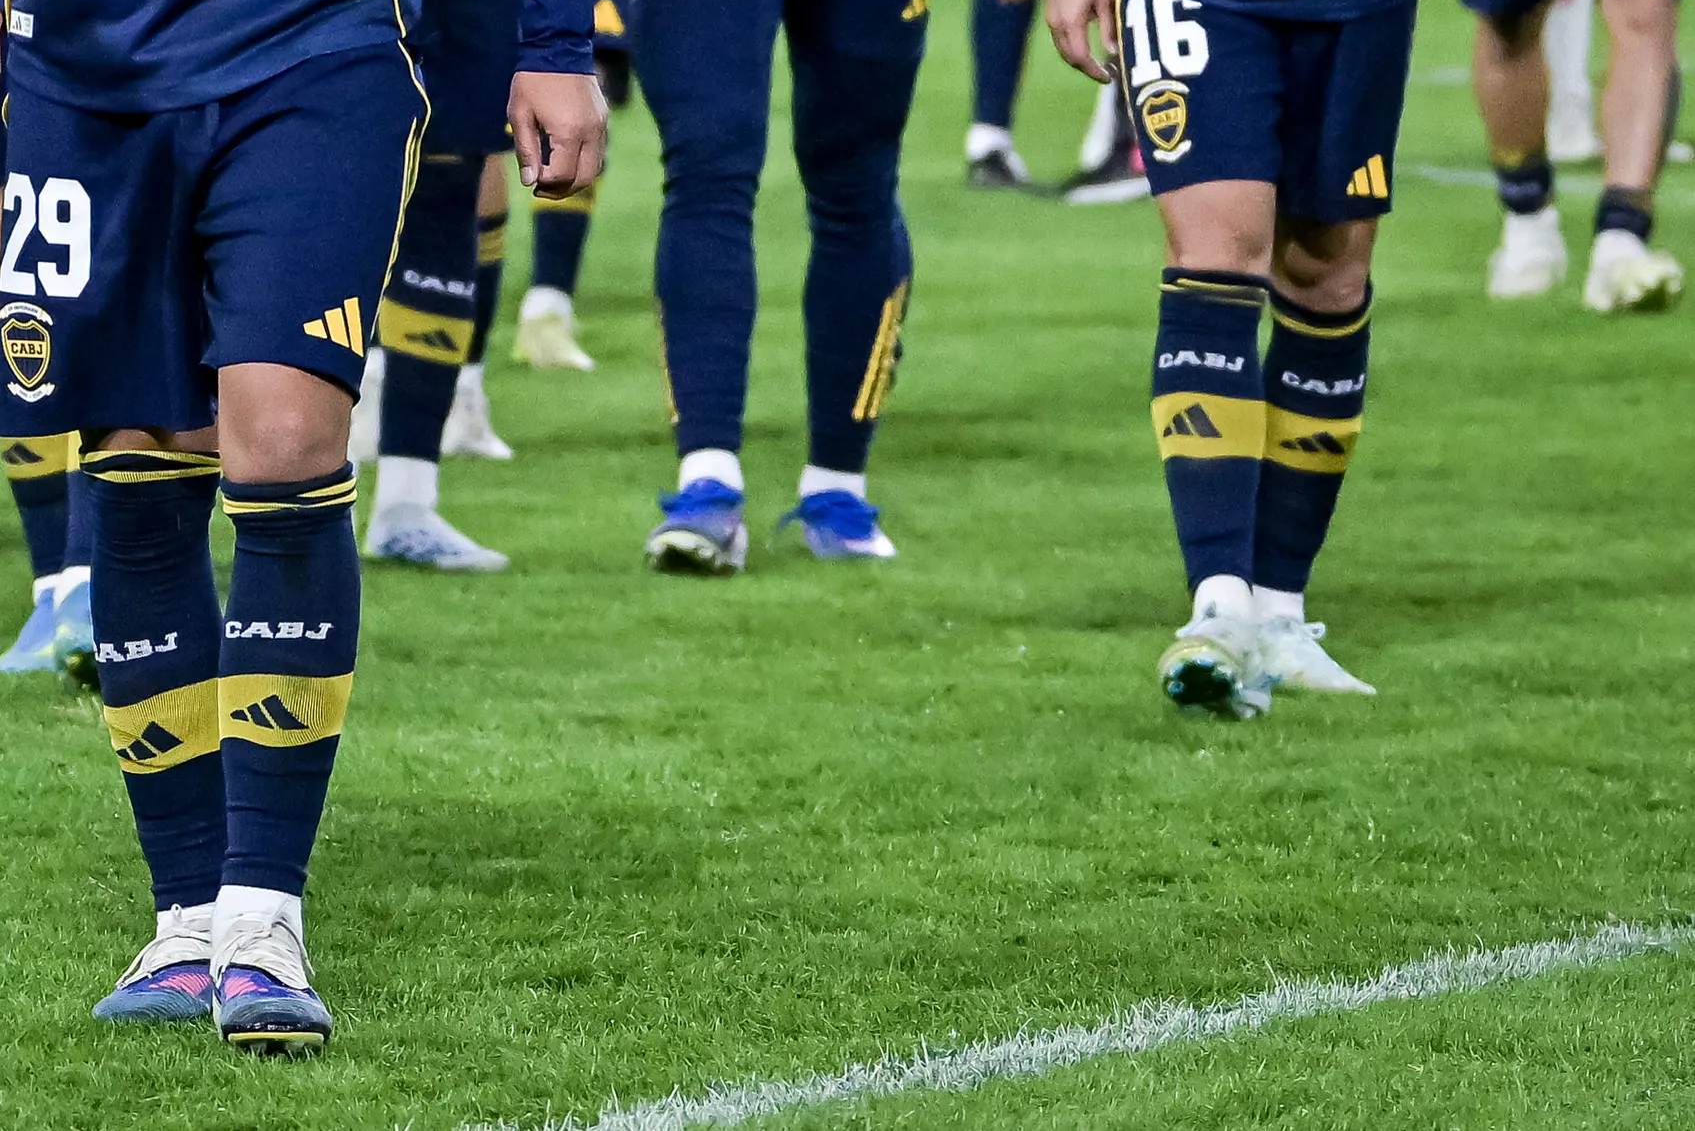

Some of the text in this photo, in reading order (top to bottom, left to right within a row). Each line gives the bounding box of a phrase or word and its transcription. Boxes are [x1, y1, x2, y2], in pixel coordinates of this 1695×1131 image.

[11, 342, 43, 355] CABJ
[1158, 350, 1245, 372] CABJ
[225, 621, 333, 640] CABJ
[94, 632, 177, 663] ABJ
